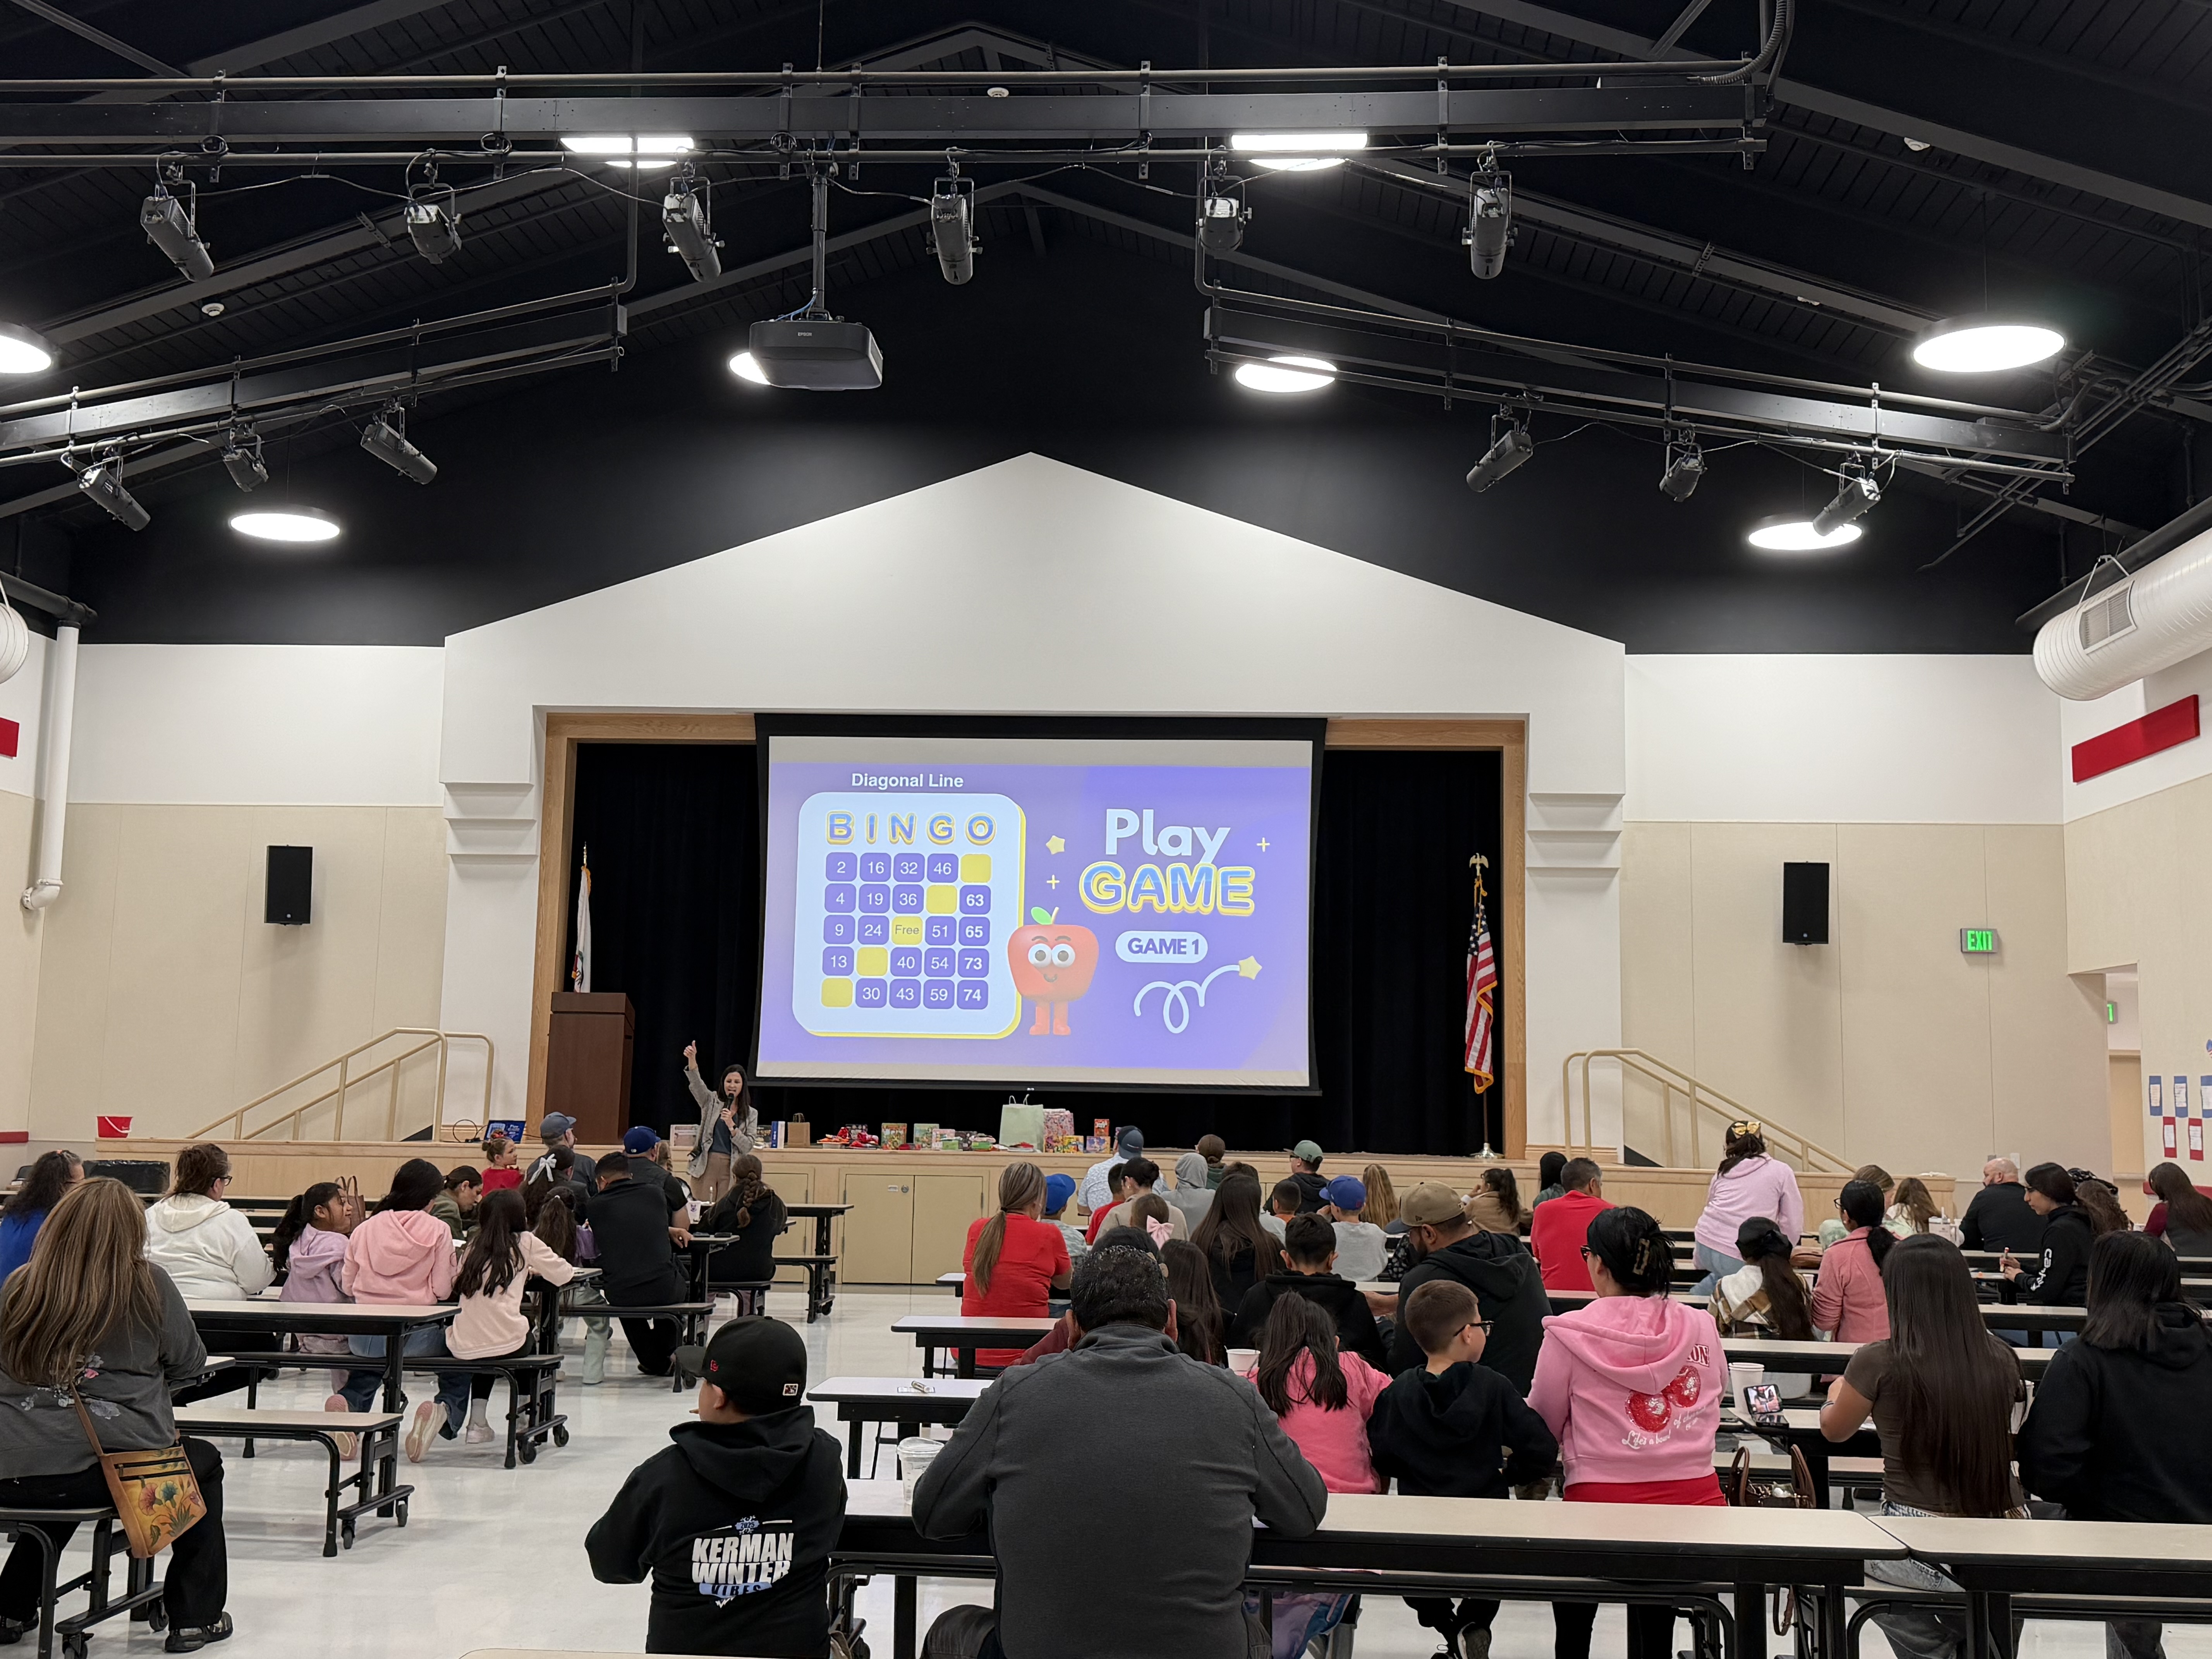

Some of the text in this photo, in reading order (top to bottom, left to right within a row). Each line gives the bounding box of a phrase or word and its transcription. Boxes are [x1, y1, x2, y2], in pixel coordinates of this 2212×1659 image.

[852, 773, 963, 790] Diagonal Line
[826, 811, 996, 845] BINGO
[1106, 809, 1231, 864] Play
[837, 861, 951, 875] 2 16 32 46
[1079, 861, 1255, 915] GAME
[836, 892, 984, 907] 4 19 36 63
[835, 924, 983, 938] 9 24 Free 51 65
[1967, 930, 1992, 950] EXIT
[1127, 938, 1199, 955] GAME 1
[831, 955, 982, 970] 13 40 54 73
[862, 987, 981, 1001] 30 43 59 74
[1687, 1345, 1709, 1366] ON
[692, 1532, 794, 1563] KERMAN
[692, 1561, 790, 1584] WINTER
